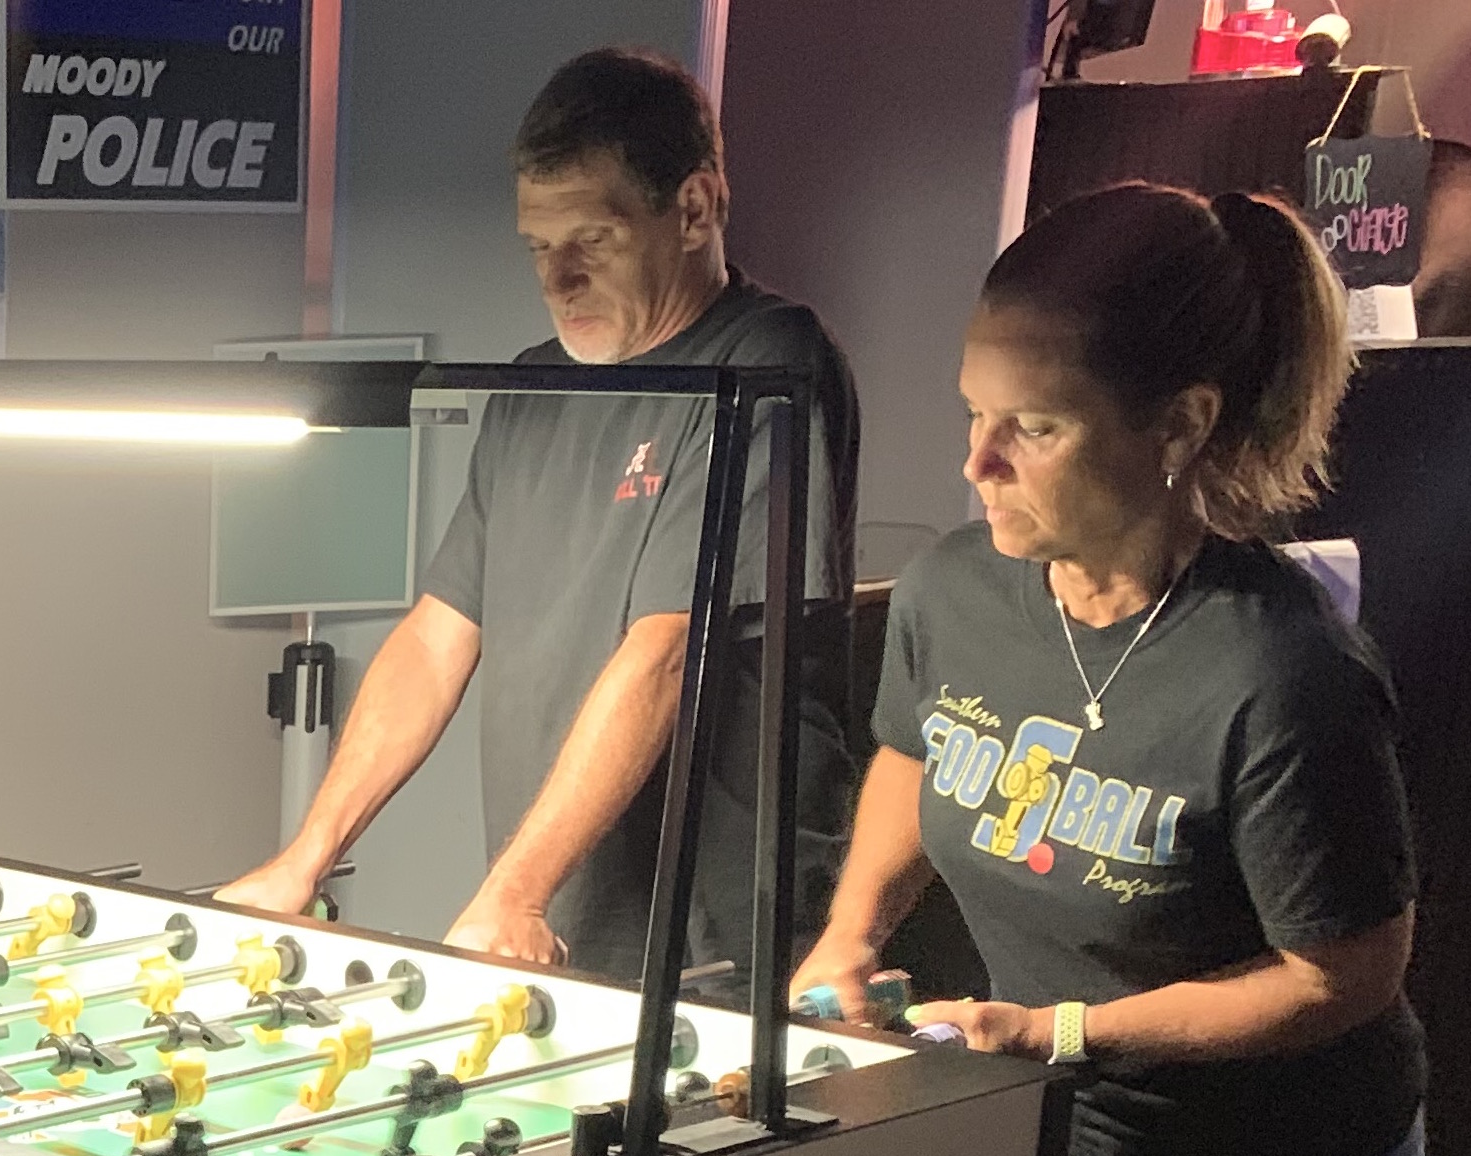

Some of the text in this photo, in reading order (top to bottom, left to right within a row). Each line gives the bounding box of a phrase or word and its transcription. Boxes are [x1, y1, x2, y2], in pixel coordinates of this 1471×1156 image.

[228, 25, 285, 54] OUR
[22, 54, 167, 98] MOODY
[36, 114, 274, 189] POLICE
[936, 685, 1002, 728] Southern
